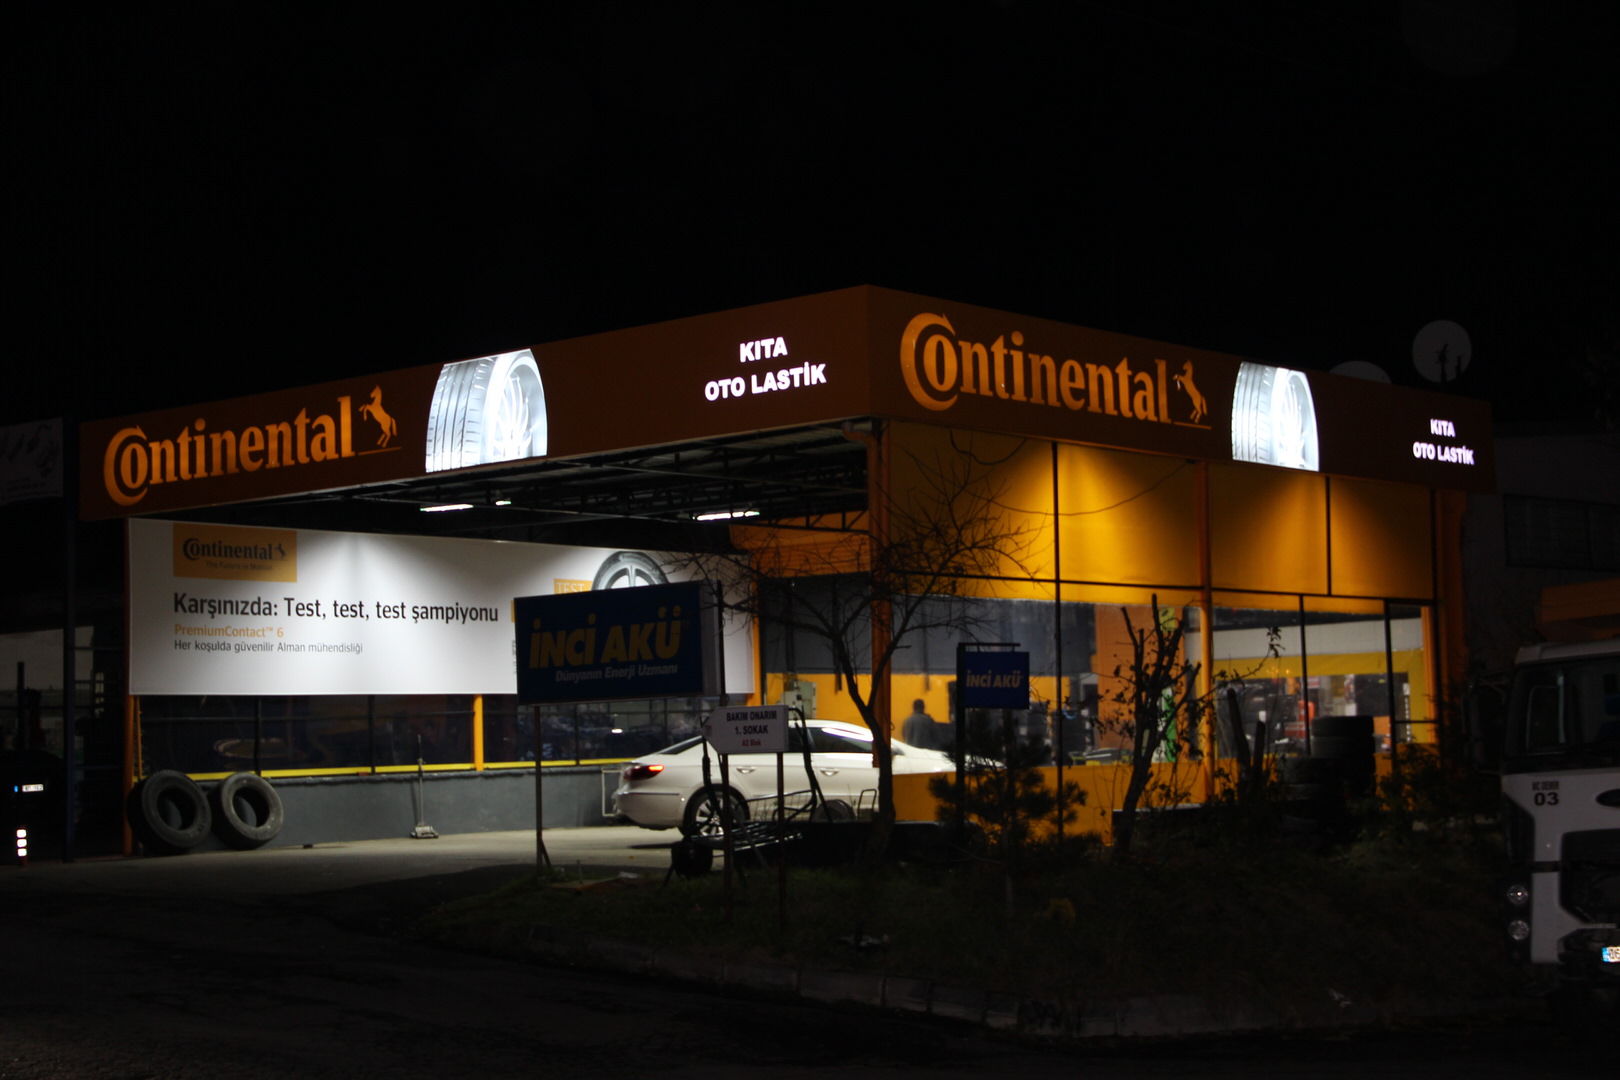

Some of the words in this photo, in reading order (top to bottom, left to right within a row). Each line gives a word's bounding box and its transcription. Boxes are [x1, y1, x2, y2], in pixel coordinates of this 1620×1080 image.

[739, 336, 789, 363] KITA
[900, 312, 1172, 424] Continental
[704, 376, 746, 402] OTO
[750, 361, 828, 395] LASTİK
[1430, 418, 1456, 438] KITA
[102, 394, 356, 507] Continental
[1412, 441, 1436, 460] OTO
[1437, 445, 1475, 466] LASTİK
[182, 537, 273, 561] Continental
[173, 592, 279, 619] Karşınızda:
[283, 597, 327, 620] Test,
[332, 599, 371, 621] test,
[375, 600, 407, 620] test
[410, 600, 499, 625] şampiyonu
[276, 627, 284, 638] 6
[174, 639, 192, 651] Her
[194, 641, 232, 653] koşulda
[233, 642, 275, 654] güvenilir
[276, 643, 306, 653] Alman
[743, 725, 768, 734] SOKAK
[1534, 791, 1560, 806] 03
